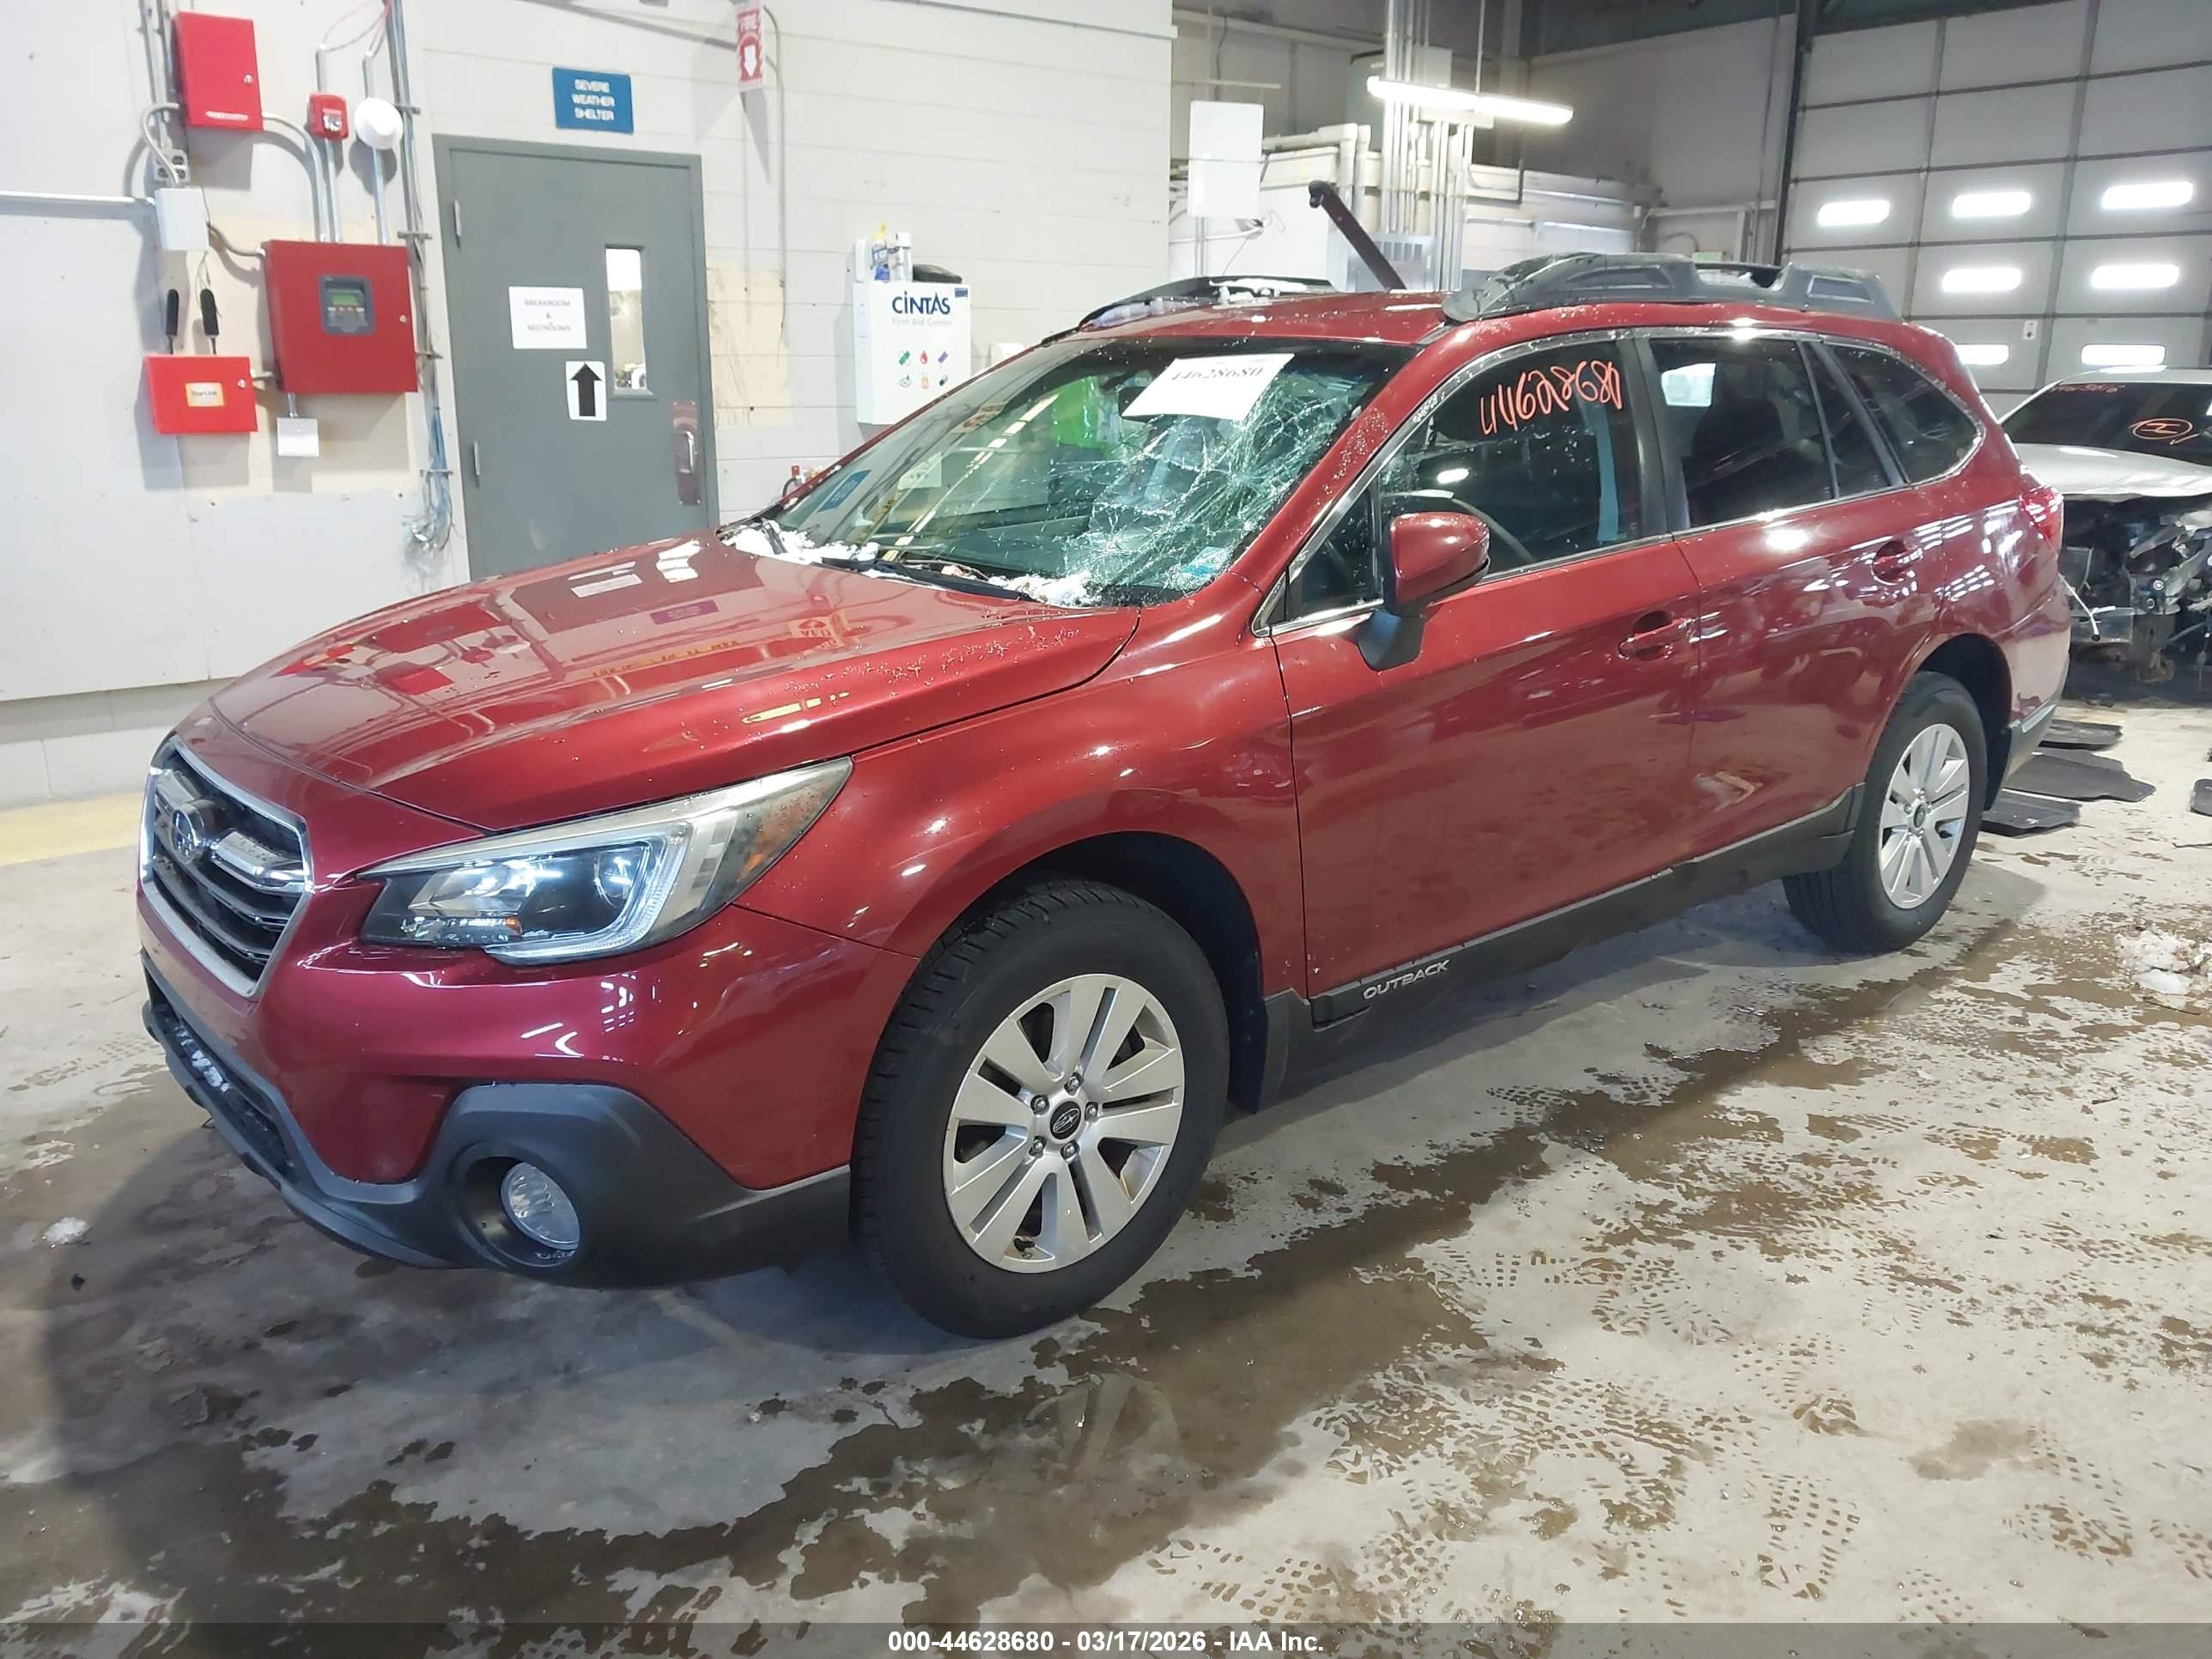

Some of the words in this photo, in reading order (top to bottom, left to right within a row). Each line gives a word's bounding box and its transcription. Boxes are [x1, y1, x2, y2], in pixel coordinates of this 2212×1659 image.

[574, 79, 611, 94] SEVERE
[570, 93, 616, 107] WEATHER
[574, 108, 615, 121] SHELTER
[892, 316, 909, 325] First
[912, 316, 925, 325] Aid
[1480, 361, 1623, 435] 44628680
[1363, 959, 1450, 1000] OUTBACK
